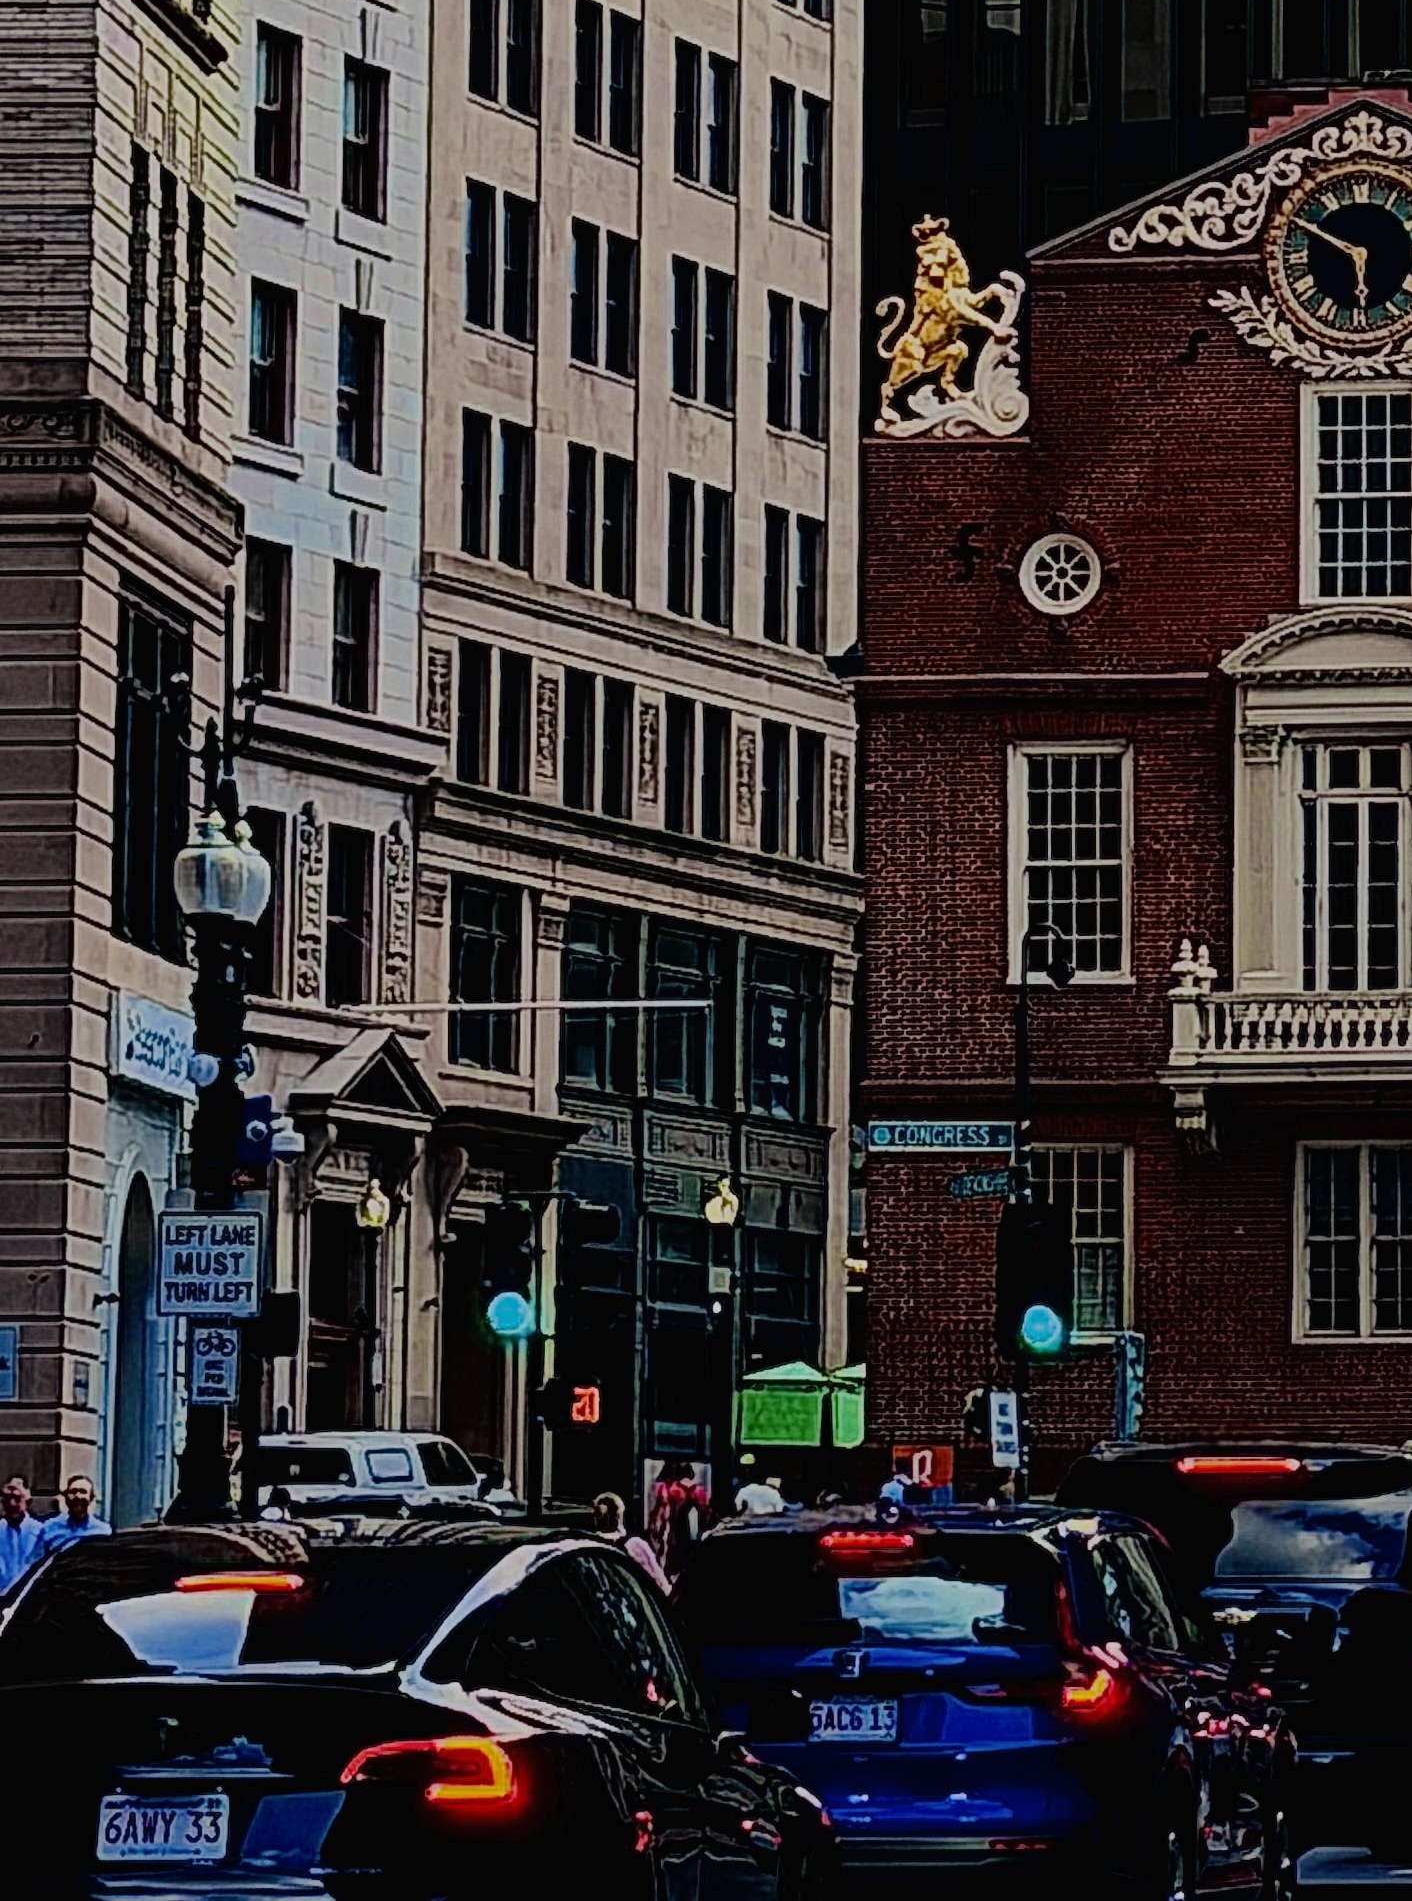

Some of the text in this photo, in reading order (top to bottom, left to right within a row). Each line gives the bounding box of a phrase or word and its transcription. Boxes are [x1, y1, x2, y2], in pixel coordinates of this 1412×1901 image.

[894, 1126, 990, 1145] CONGRESS
[165, 1225, 255, 1246] LEFT LANE
[174, 1251, 245, 1276] MUST
[164, 1281, 254, 1303] TURN LEFT
[105, 1810, 222, 1844] 6AWY 33
